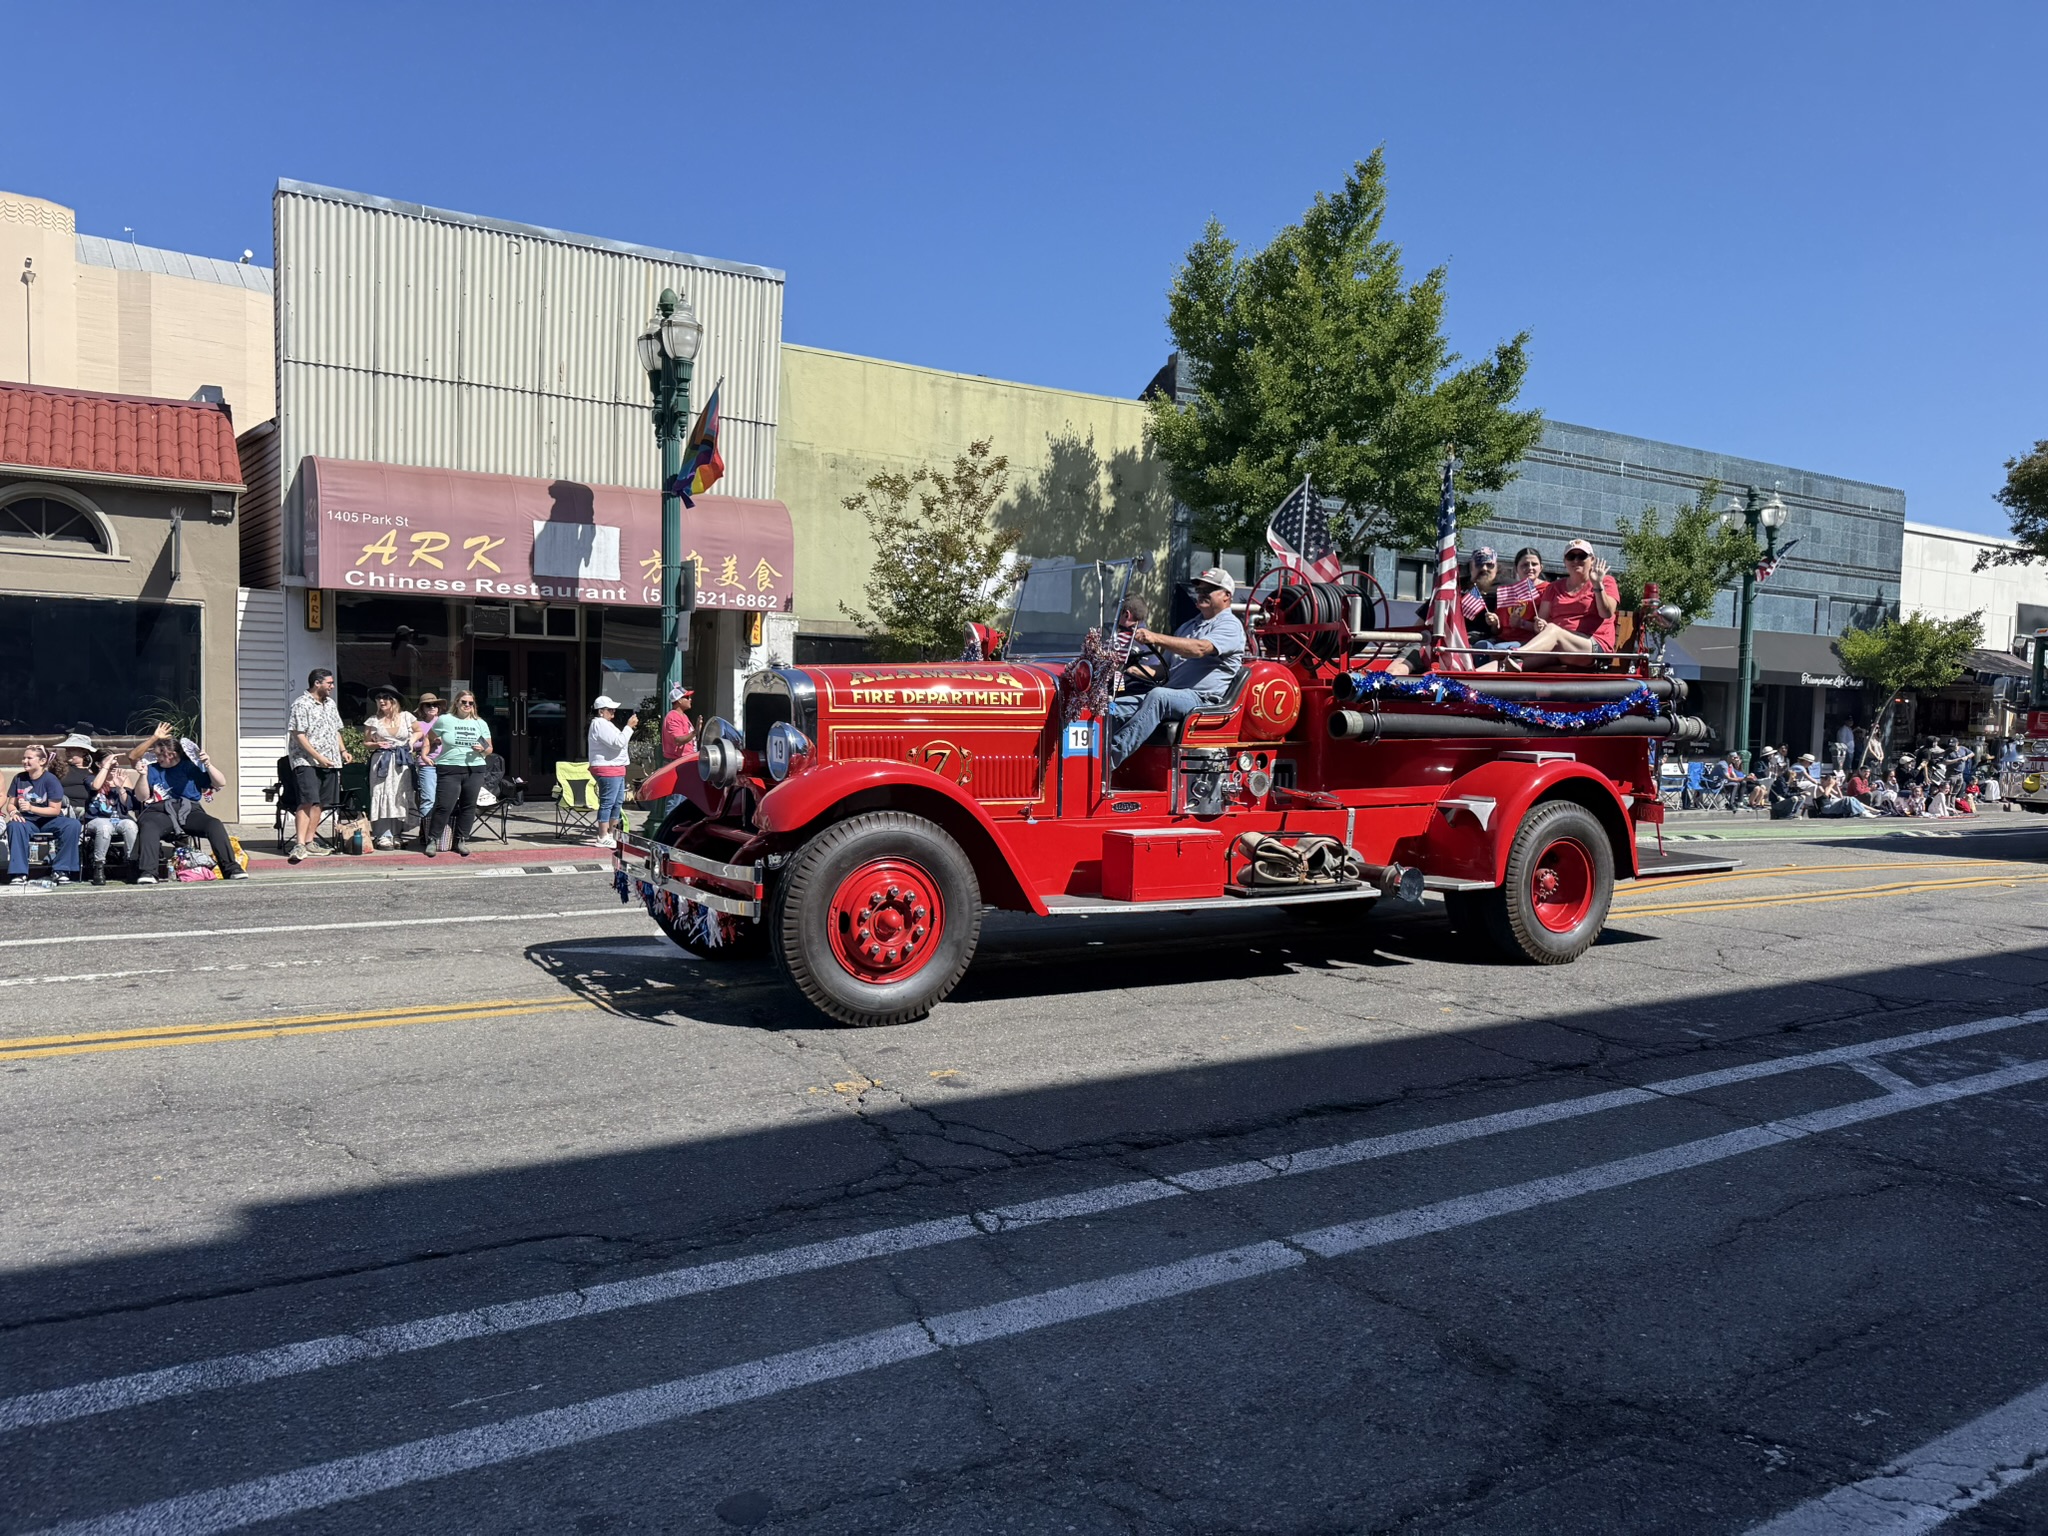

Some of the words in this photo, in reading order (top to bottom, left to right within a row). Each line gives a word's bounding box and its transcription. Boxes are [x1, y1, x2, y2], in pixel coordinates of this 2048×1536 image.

[327, 510, 359, 523] 1405
[362, 513, 392, 525] Park
[395, 516, 409, 527] St
[355, 529, 506, 574] ARK
[345, 570, 466, 592] Chinese
[475, 578, 627, 601] Restaurant
[696, 591, 778, 609] 521-6862
[849, 669, 1024, 689] ALAMEDA
[852, 689, 896, 704] FIRE
[901, 690, 1024, 706] DEPARTMENT
[1273, 690, 1287, 715] 7
[1071, 730, 1090, 747] 19
[774, 740, 783, 759] 19
[925, 749, 951, 775] 7
